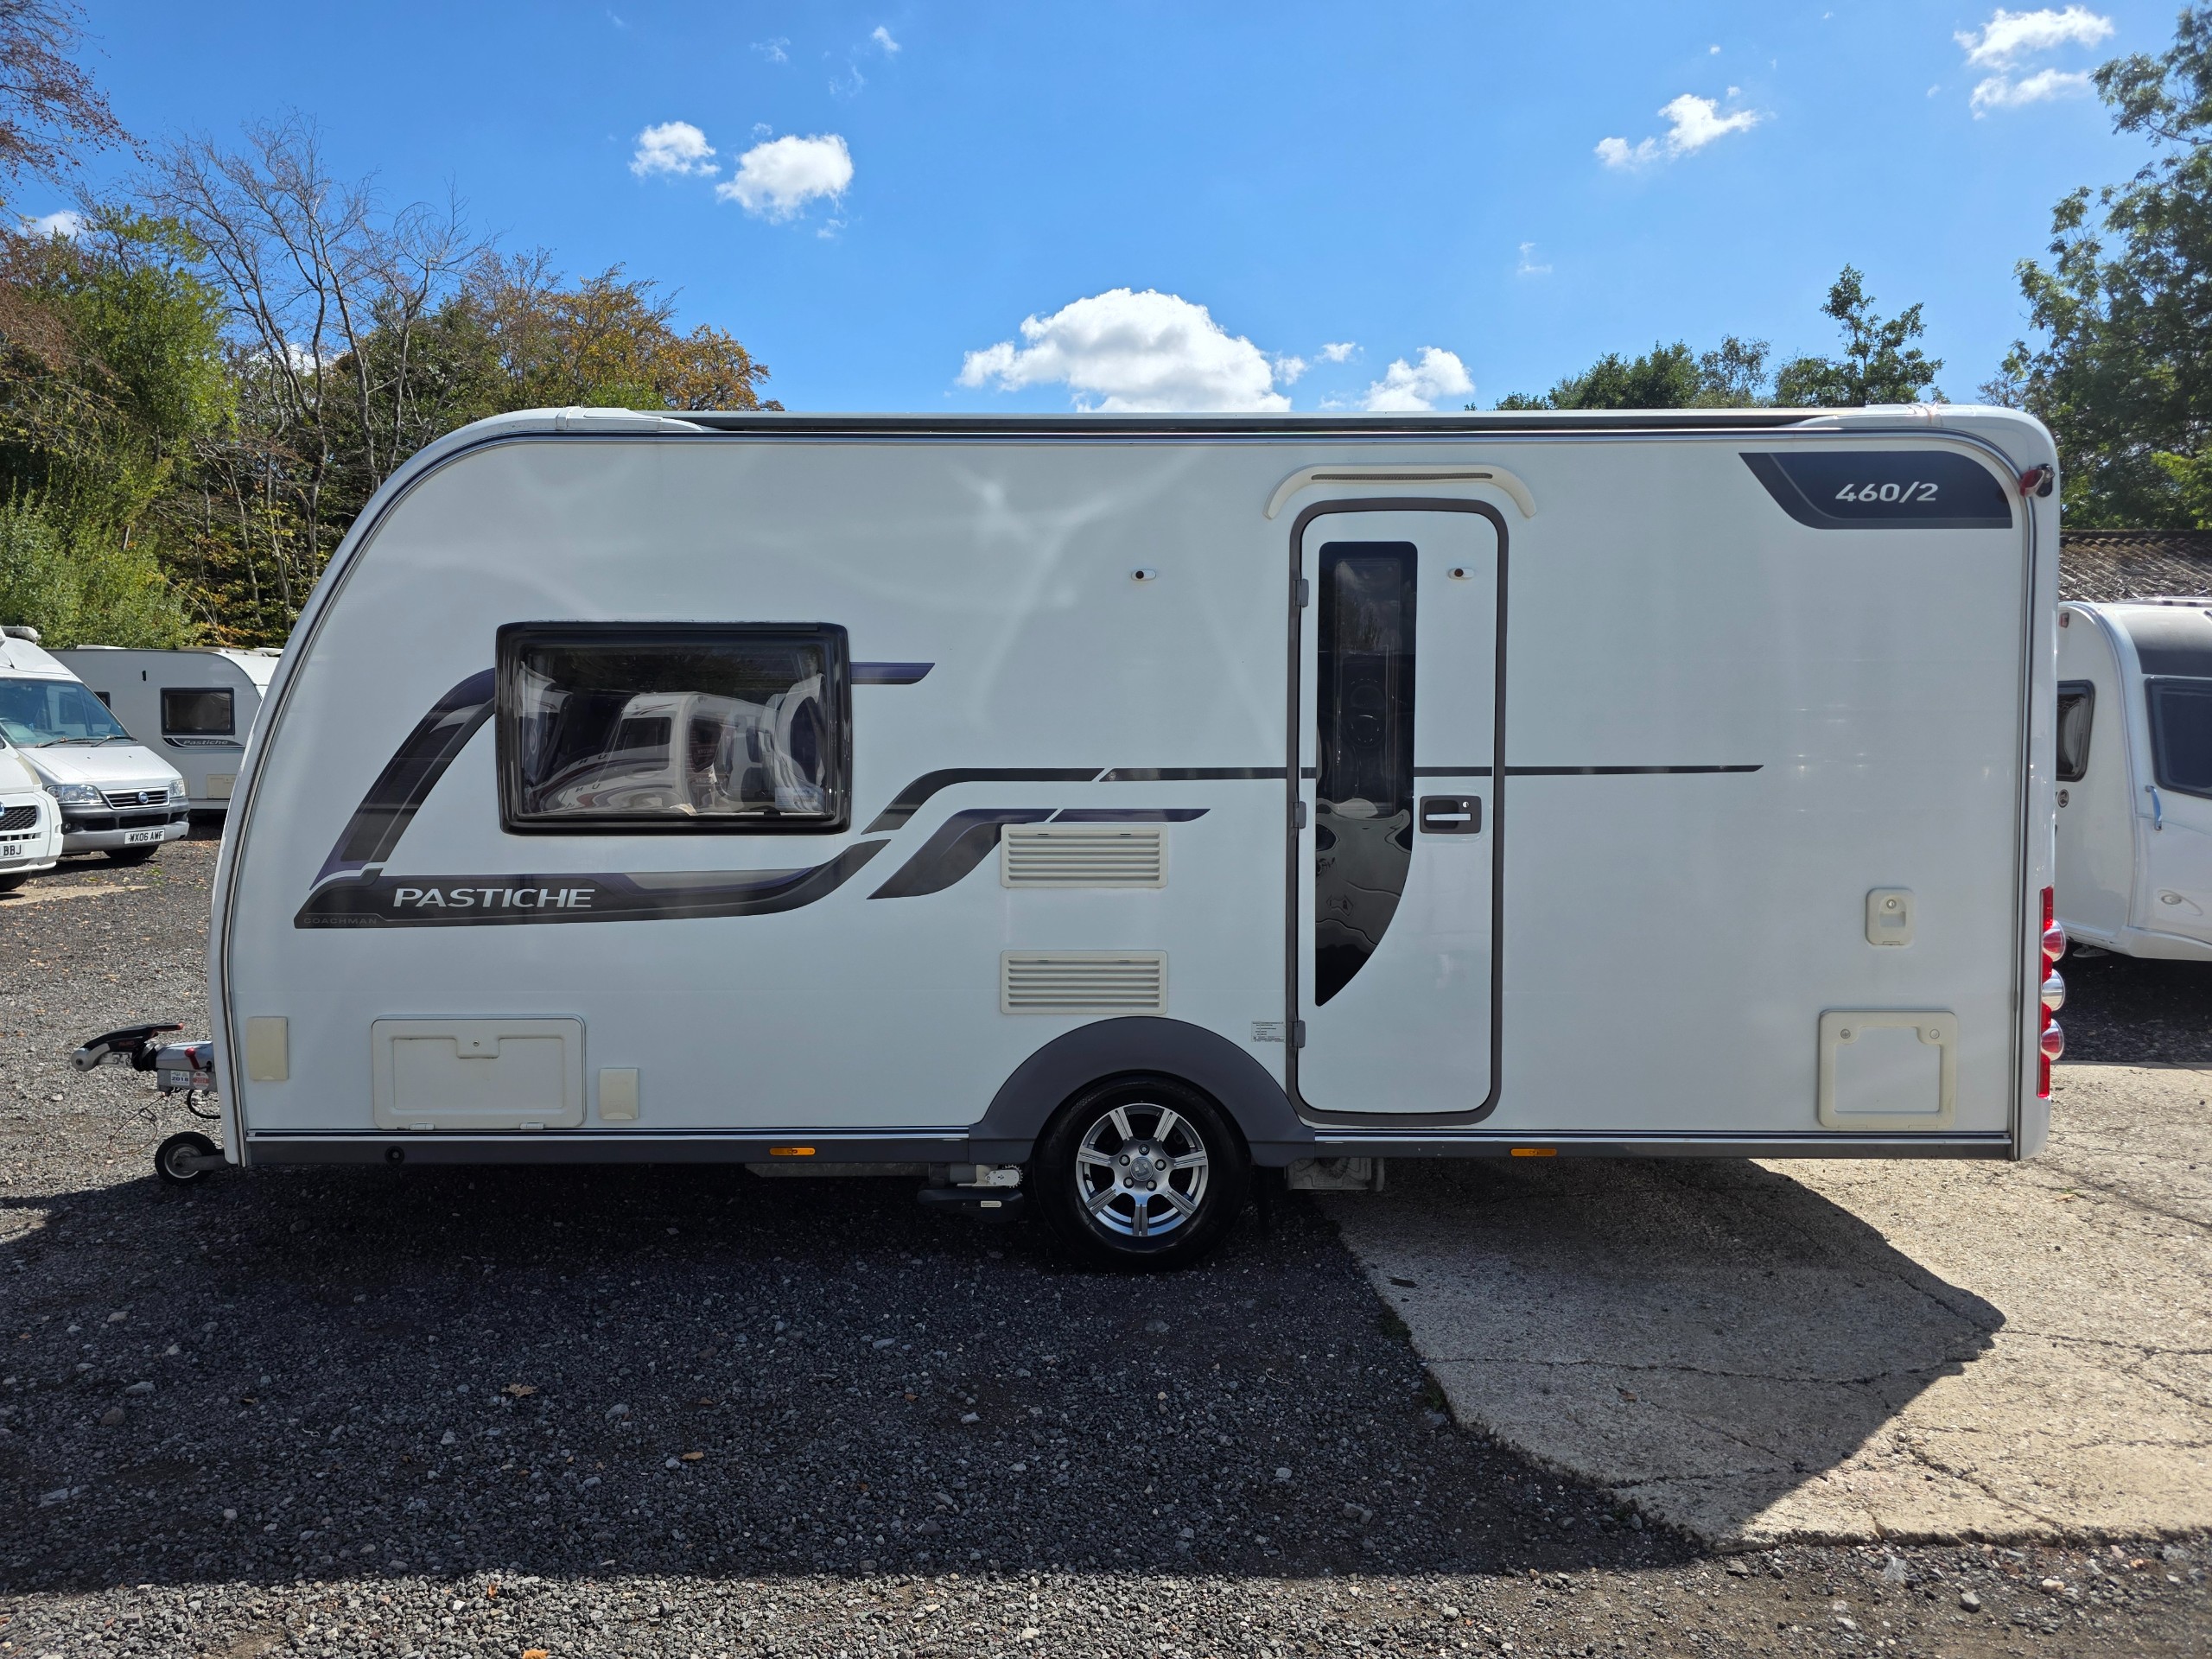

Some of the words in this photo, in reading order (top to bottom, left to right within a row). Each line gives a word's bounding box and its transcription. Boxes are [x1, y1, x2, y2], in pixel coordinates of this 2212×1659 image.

[1835, 481, 1938, 503] 460/2
[130, 832, 149, 842] WX06
[150, 830, 164, 841] AWF
[3, 844, 22, 856] BBJ
[393, 888, 595, 907] PASTICHE
